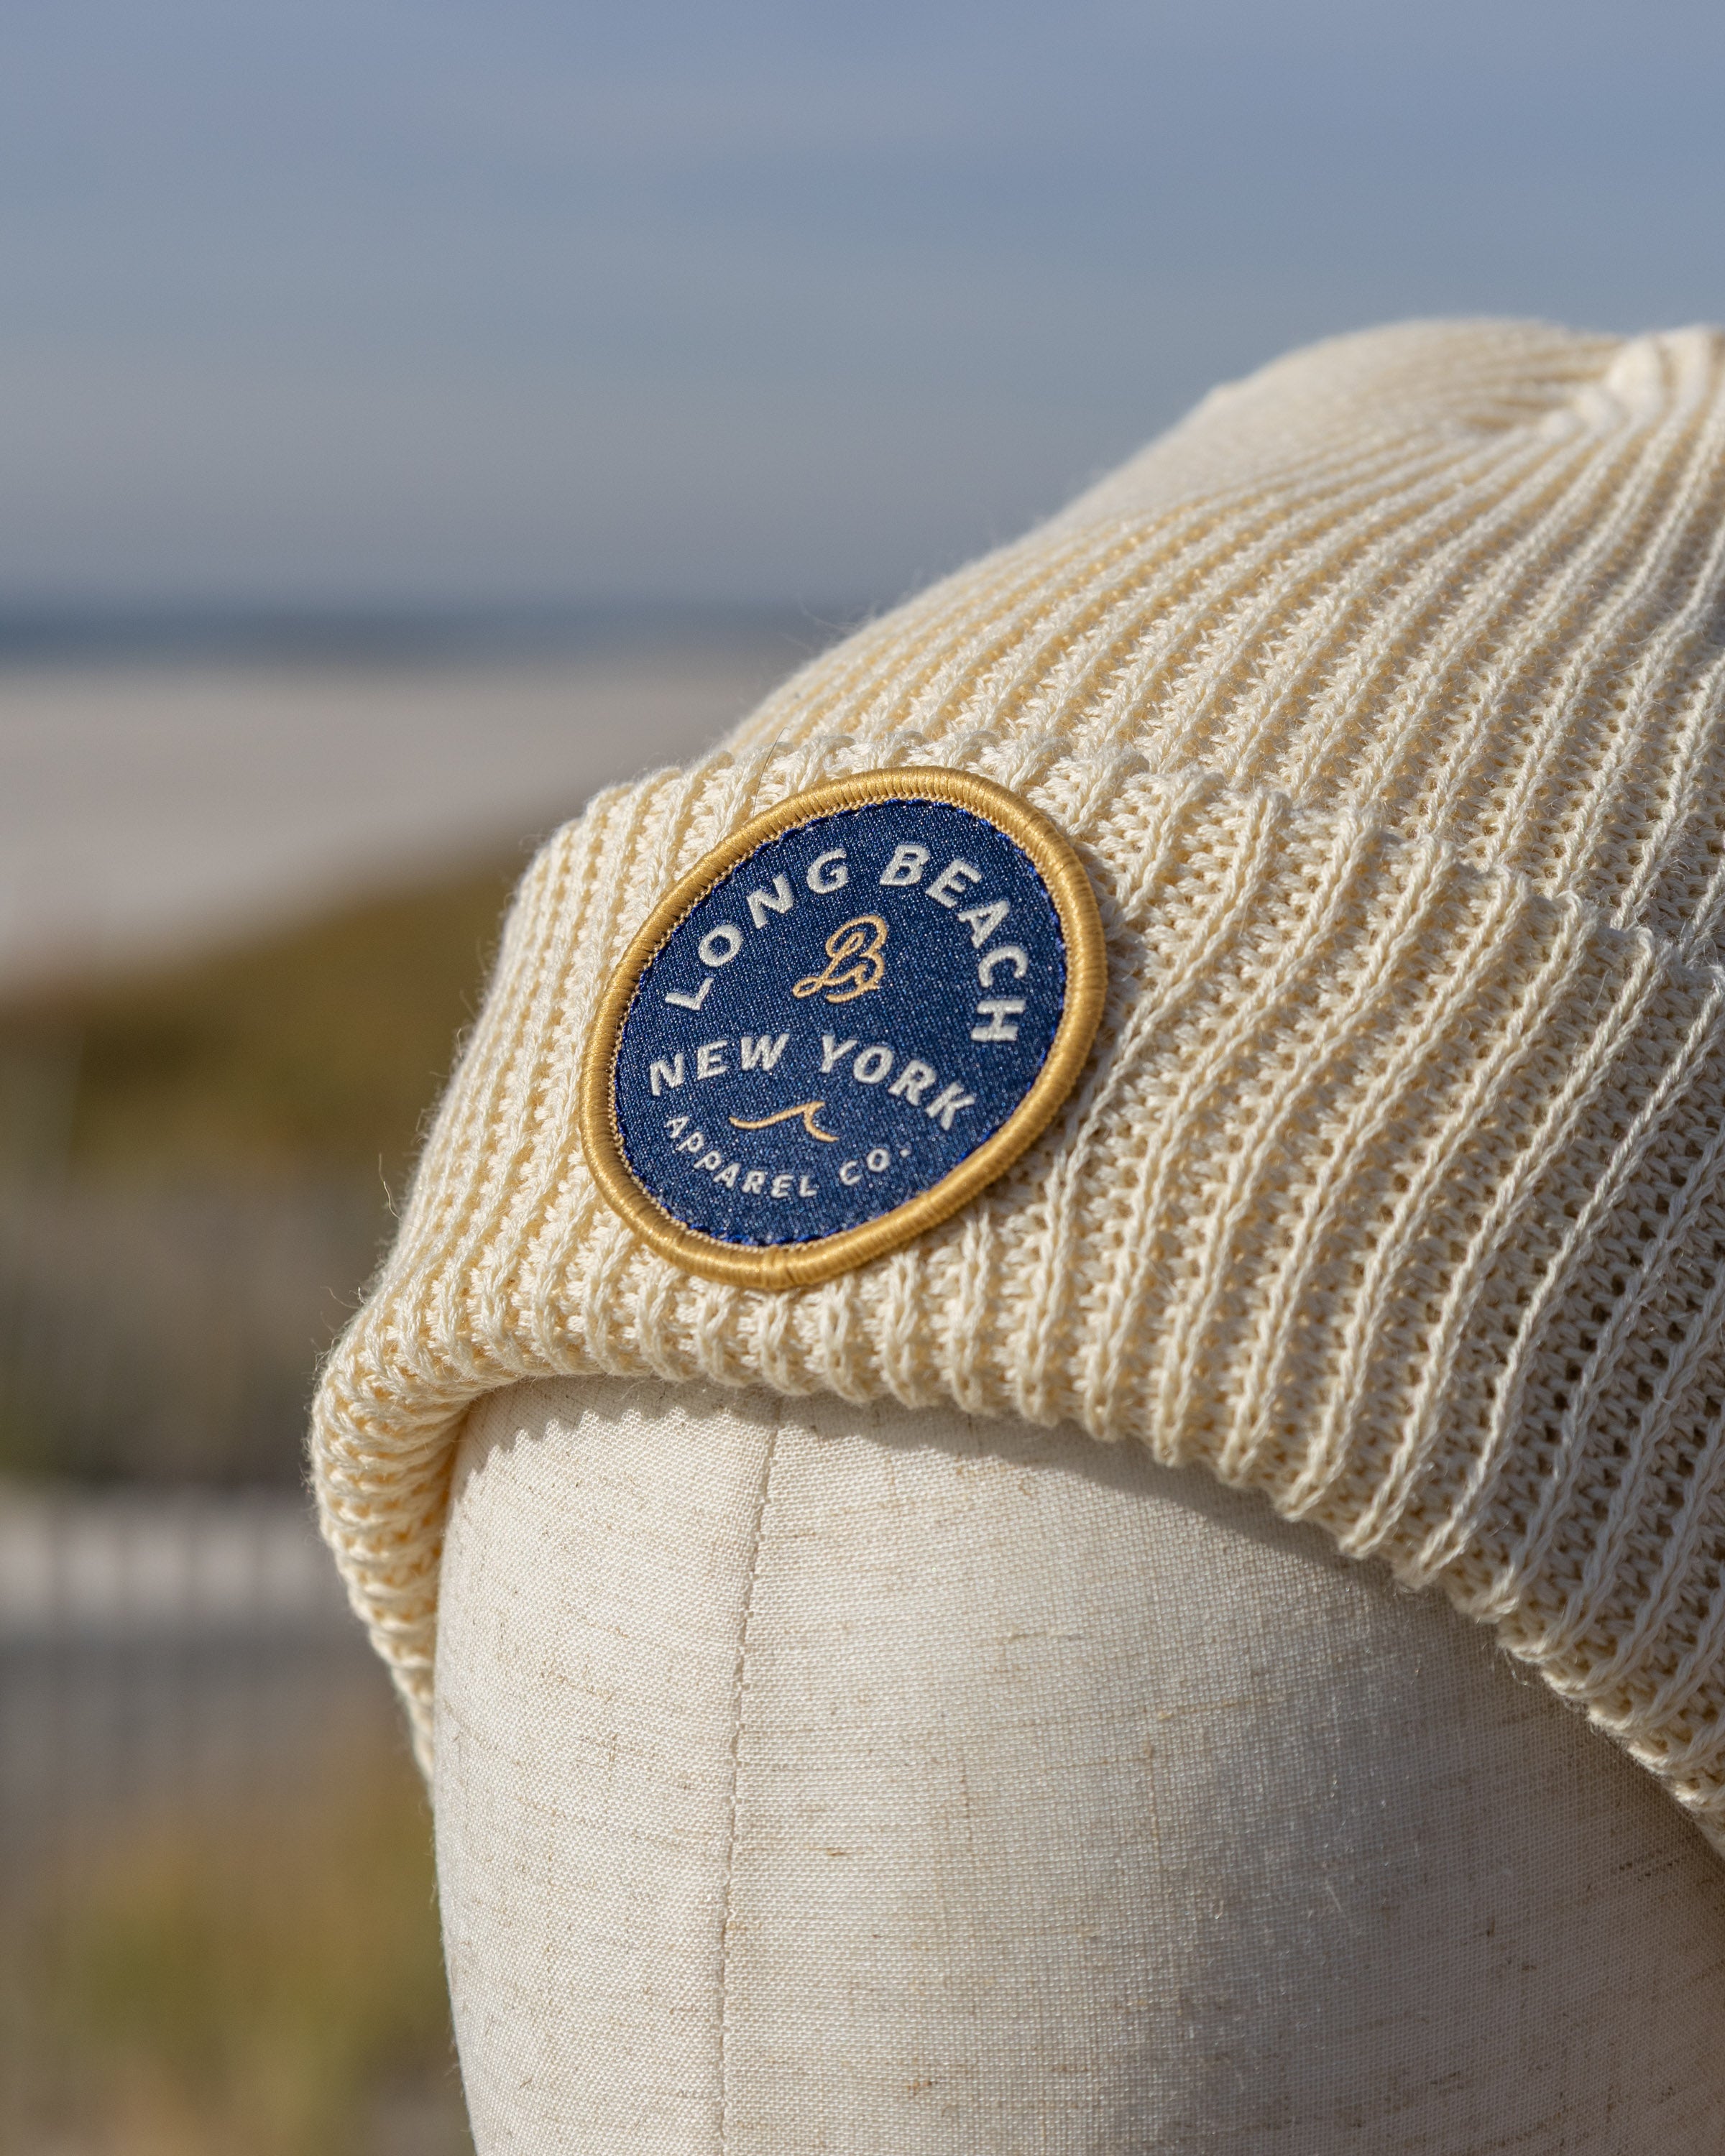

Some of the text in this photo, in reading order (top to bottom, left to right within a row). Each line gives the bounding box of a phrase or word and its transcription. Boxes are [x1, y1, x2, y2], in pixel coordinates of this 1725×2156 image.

[666, 844, 1029, 1042] LONG BEACH
[650, 1033, 975, 1130] NEW YORK
[665, 1115, 911, 1198] APPAREL CO.
